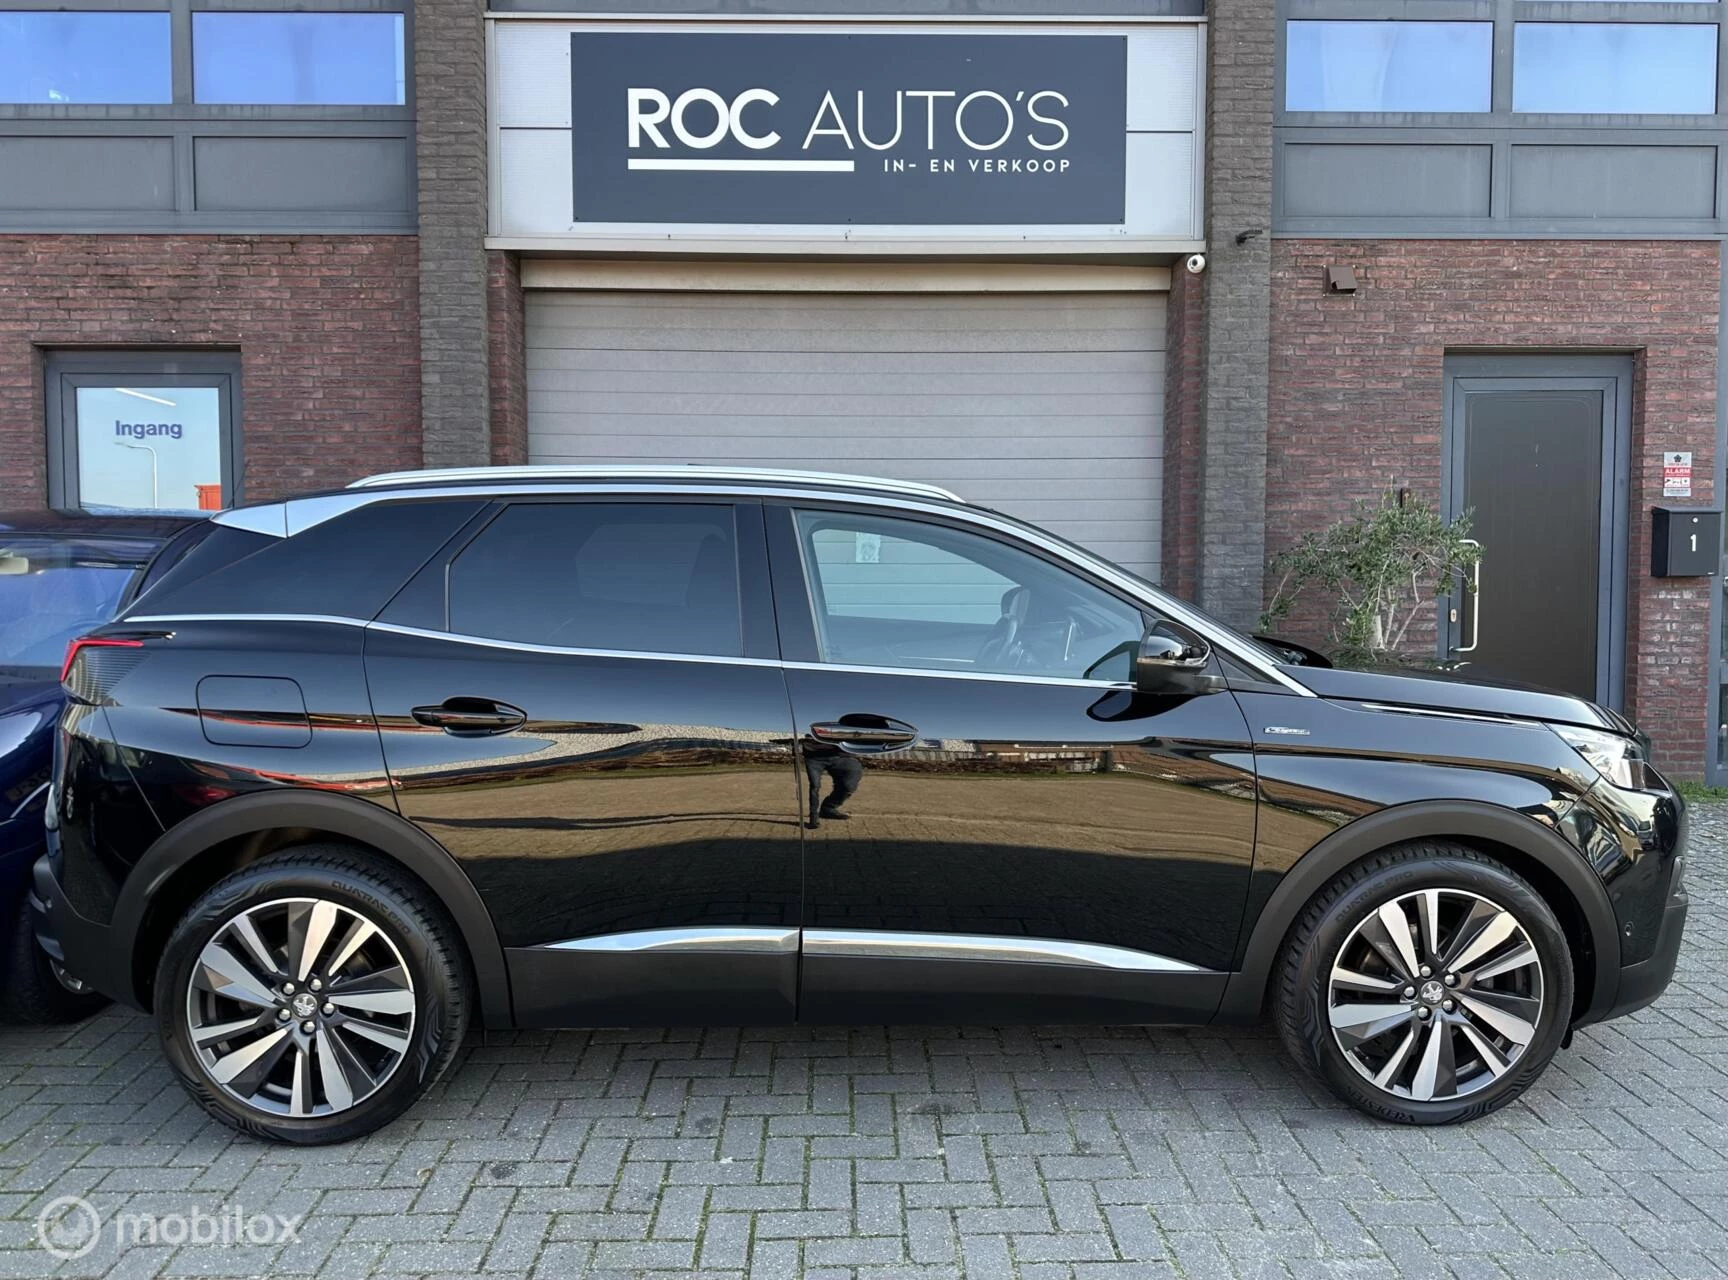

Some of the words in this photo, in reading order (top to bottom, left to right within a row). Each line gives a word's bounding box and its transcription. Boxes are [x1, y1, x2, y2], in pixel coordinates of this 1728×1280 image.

[627, 87, 781, 150] ROC
[802, 90, 1070, 151] AUTO'S
[884, 159, 918, 173] IN-
[930, 159, 955, 173] EN
[968, 159, 1071, 173] VERKOOP
[115, 420, 183, 439] Ingang
[1690, 534, 1697, 552] 1
[331, 880, 388, 913] QUATRAC
